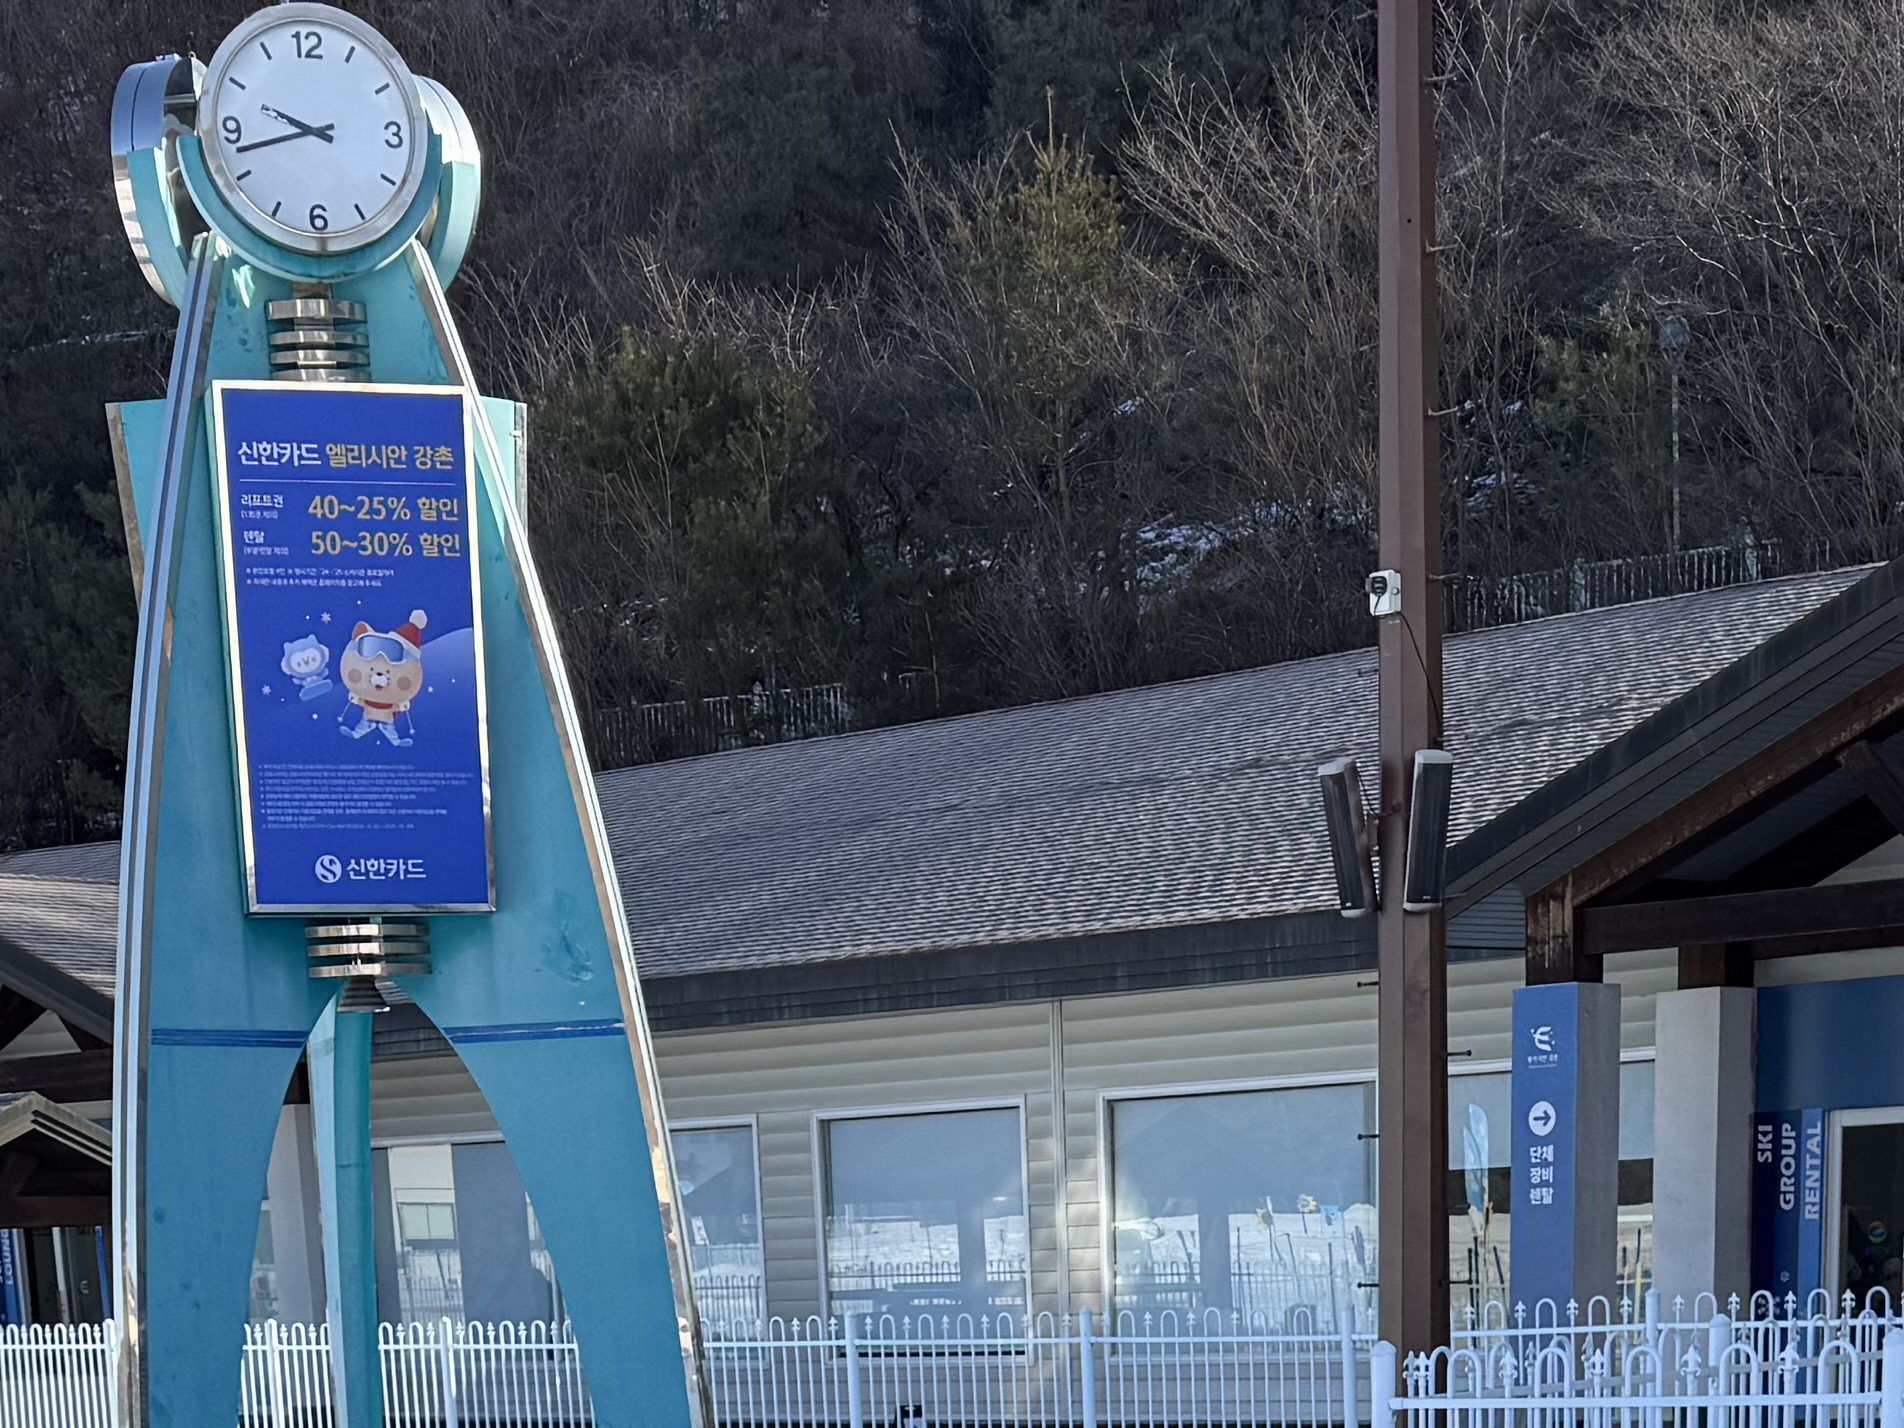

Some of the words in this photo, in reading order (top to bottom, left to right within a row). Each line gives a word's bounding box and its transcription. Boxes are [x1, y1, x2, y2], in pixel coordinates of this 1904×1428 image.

[291, 31, 323, 60] 12
[222, 116, 242, 144] 9
[384, 121, 403, 149] 3
[309, 204, 328, 231] 6
[238, 441, 322, 466] 신한카드
[325, 443, 407, 469] 엘리시안
[413, 445, 454, 470] 강촌
[240, 494, 284, 509] 리프트권
[308, 495, 411, 521] 40~25%
[417, 497, 460, 522] 할인
[311, 530, 413, 556] 50~30%
[419, 533, 461, 557] 할인
[346, 858, 427, 880] 신한카드
[1530, 1145, 1554, 1163] 단체
[1757, 1124, 1773, 1163] SKI
[1530, 1166, 1553, 1184] 장비
[1779, 1122, 1796, 1211] GROUP
[1804, 1121, 1822, 1219] RENTAL
[1529, 1187, 1553, 1205] 렌탈
